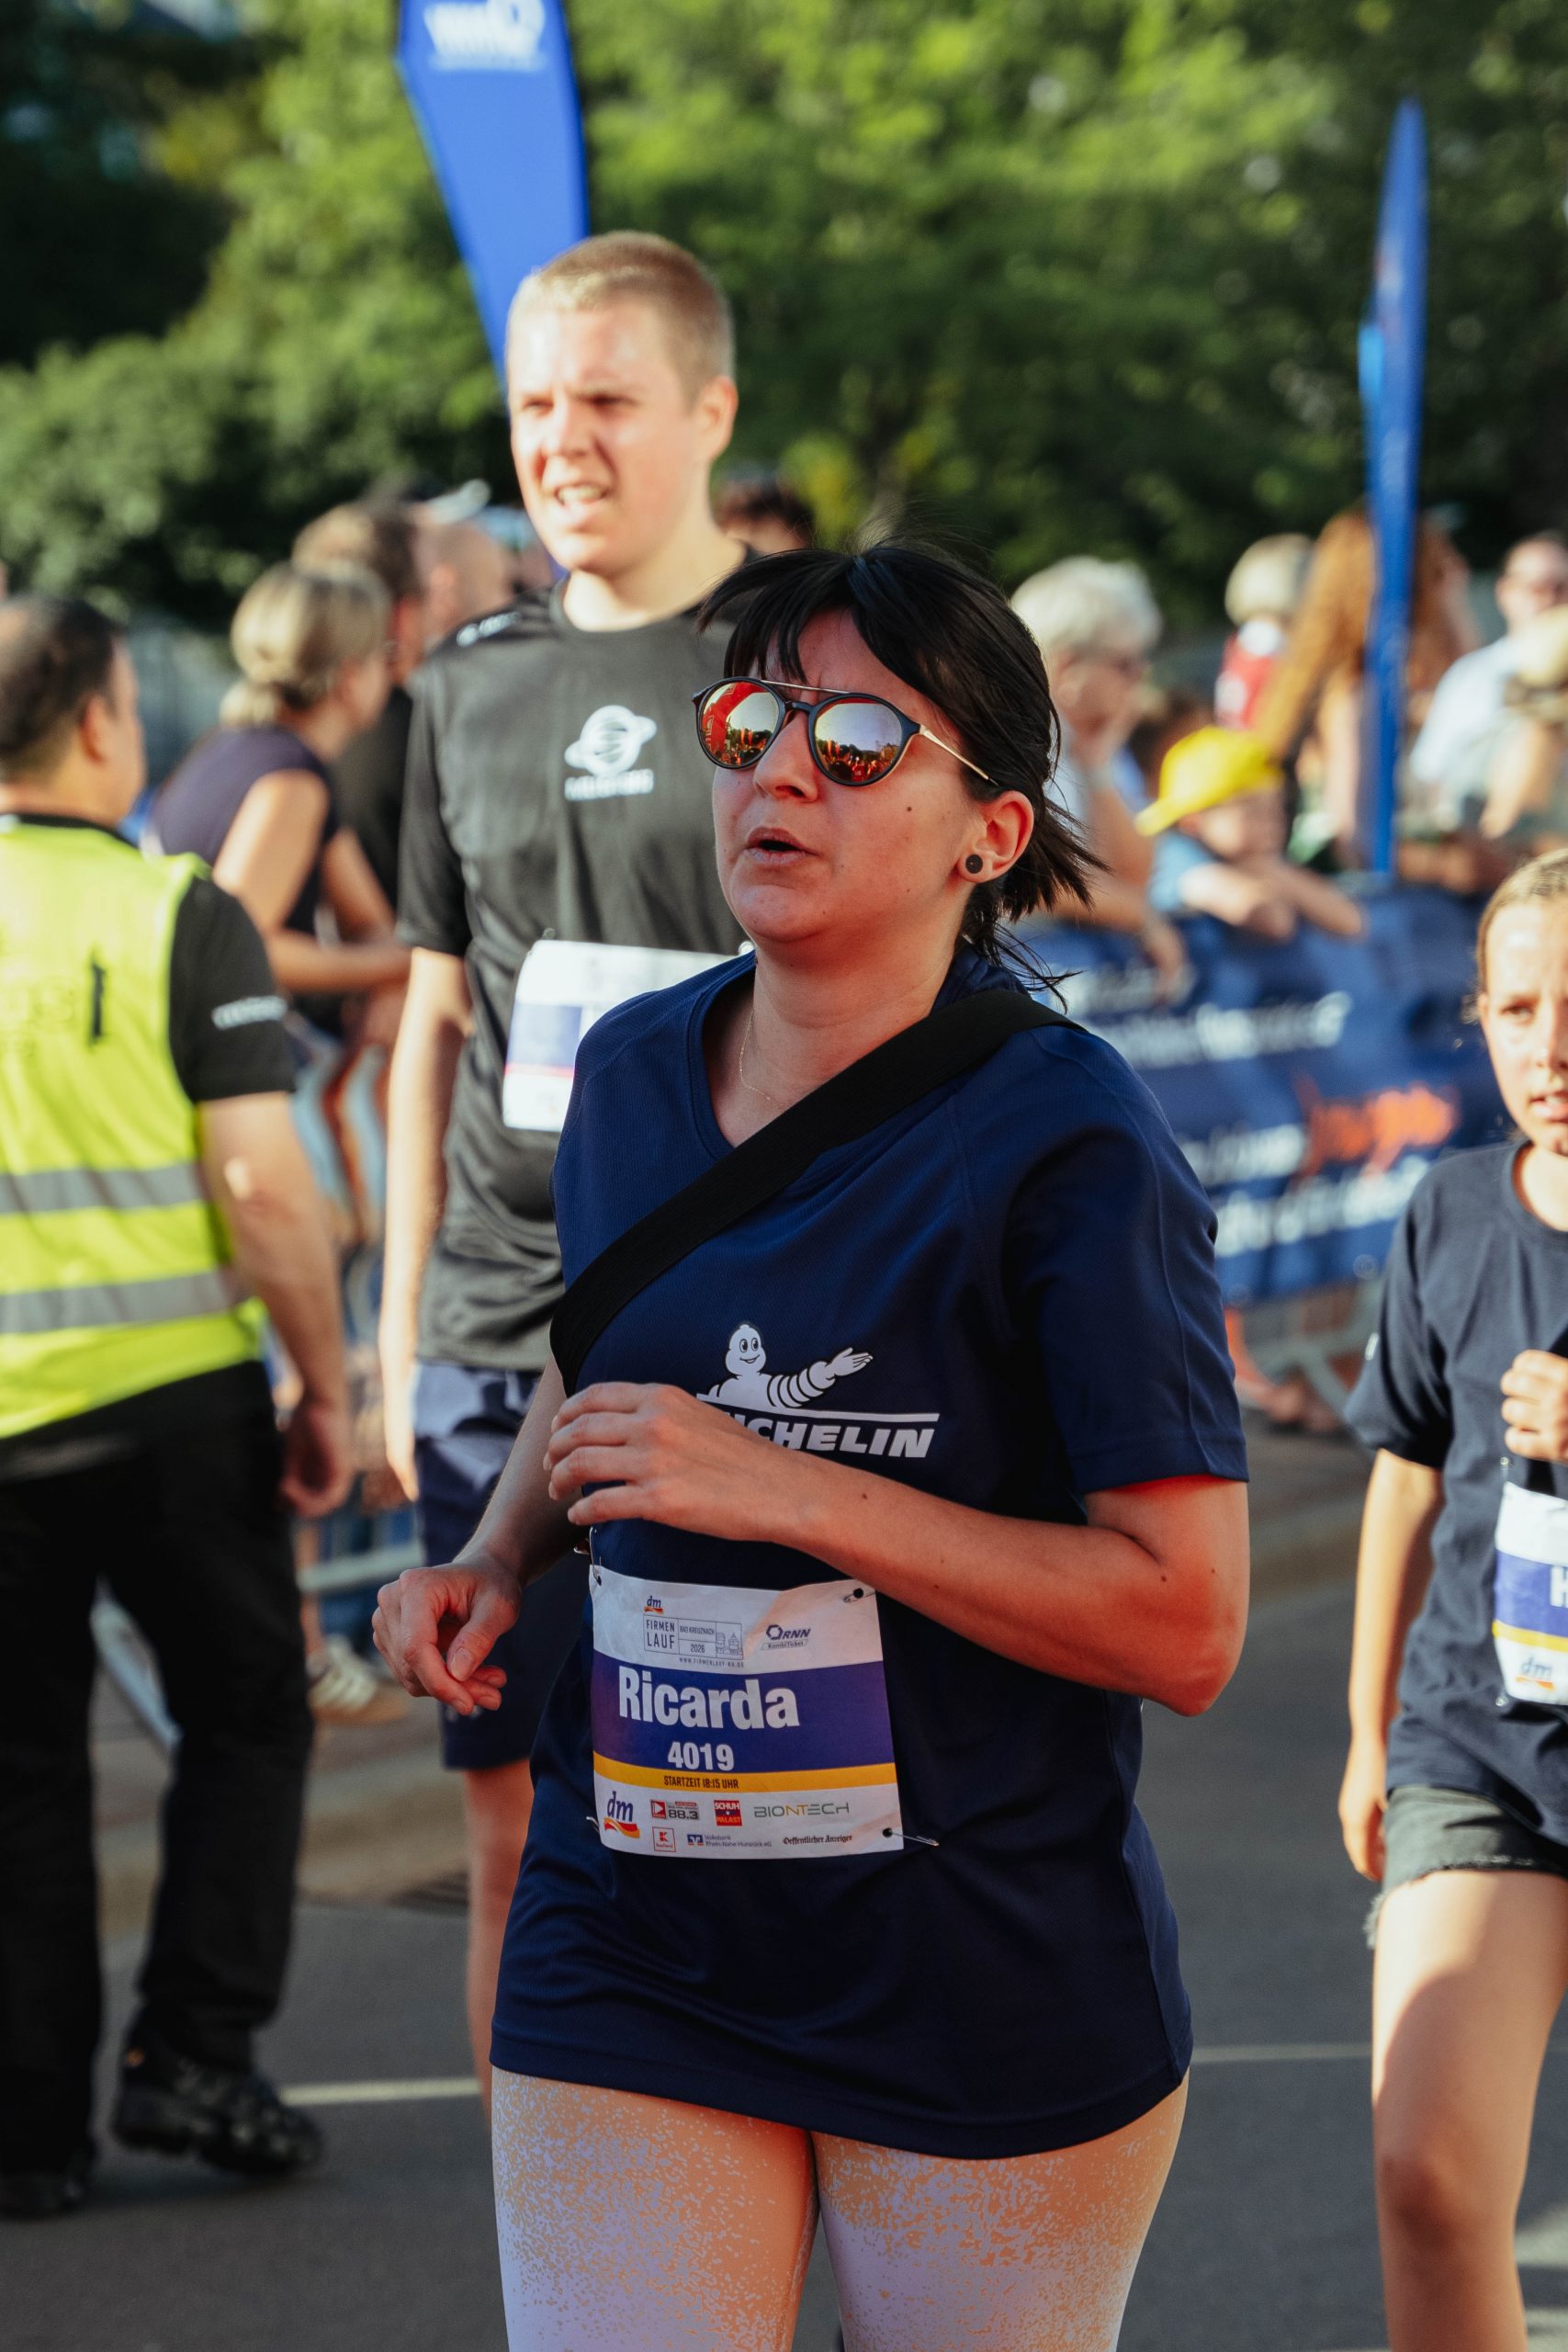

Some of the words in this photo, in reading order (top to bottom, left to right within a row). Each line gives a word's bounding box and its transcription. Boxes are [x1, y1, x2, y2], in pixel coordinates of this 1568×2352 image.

[647, 1596, 661, 1608] dm
[646, 1620, 675, 1633] FIRMEN
[647, 1632, 675, 1650] LAUF
[691, 1644, 705, 1654] 2026
[619, 1666, 800, 1730] Ricarda
[667, 1741, 735, 1771] 4019
[664, 1775, 701, 1788] STARTZEIT
[702, 1778, 721, 1789] 18:15
[722, 1779, 739, 1789] UHR
[607, 1791, 634, 1822] dm
[715, 1802, 740, 1810] SCHUH
[668, 1810, 699, 1820] 88.3
[783, 1836, 824, 1846] Oeffentlicher
[825, 1834, 852, 1844] Anzeiger
